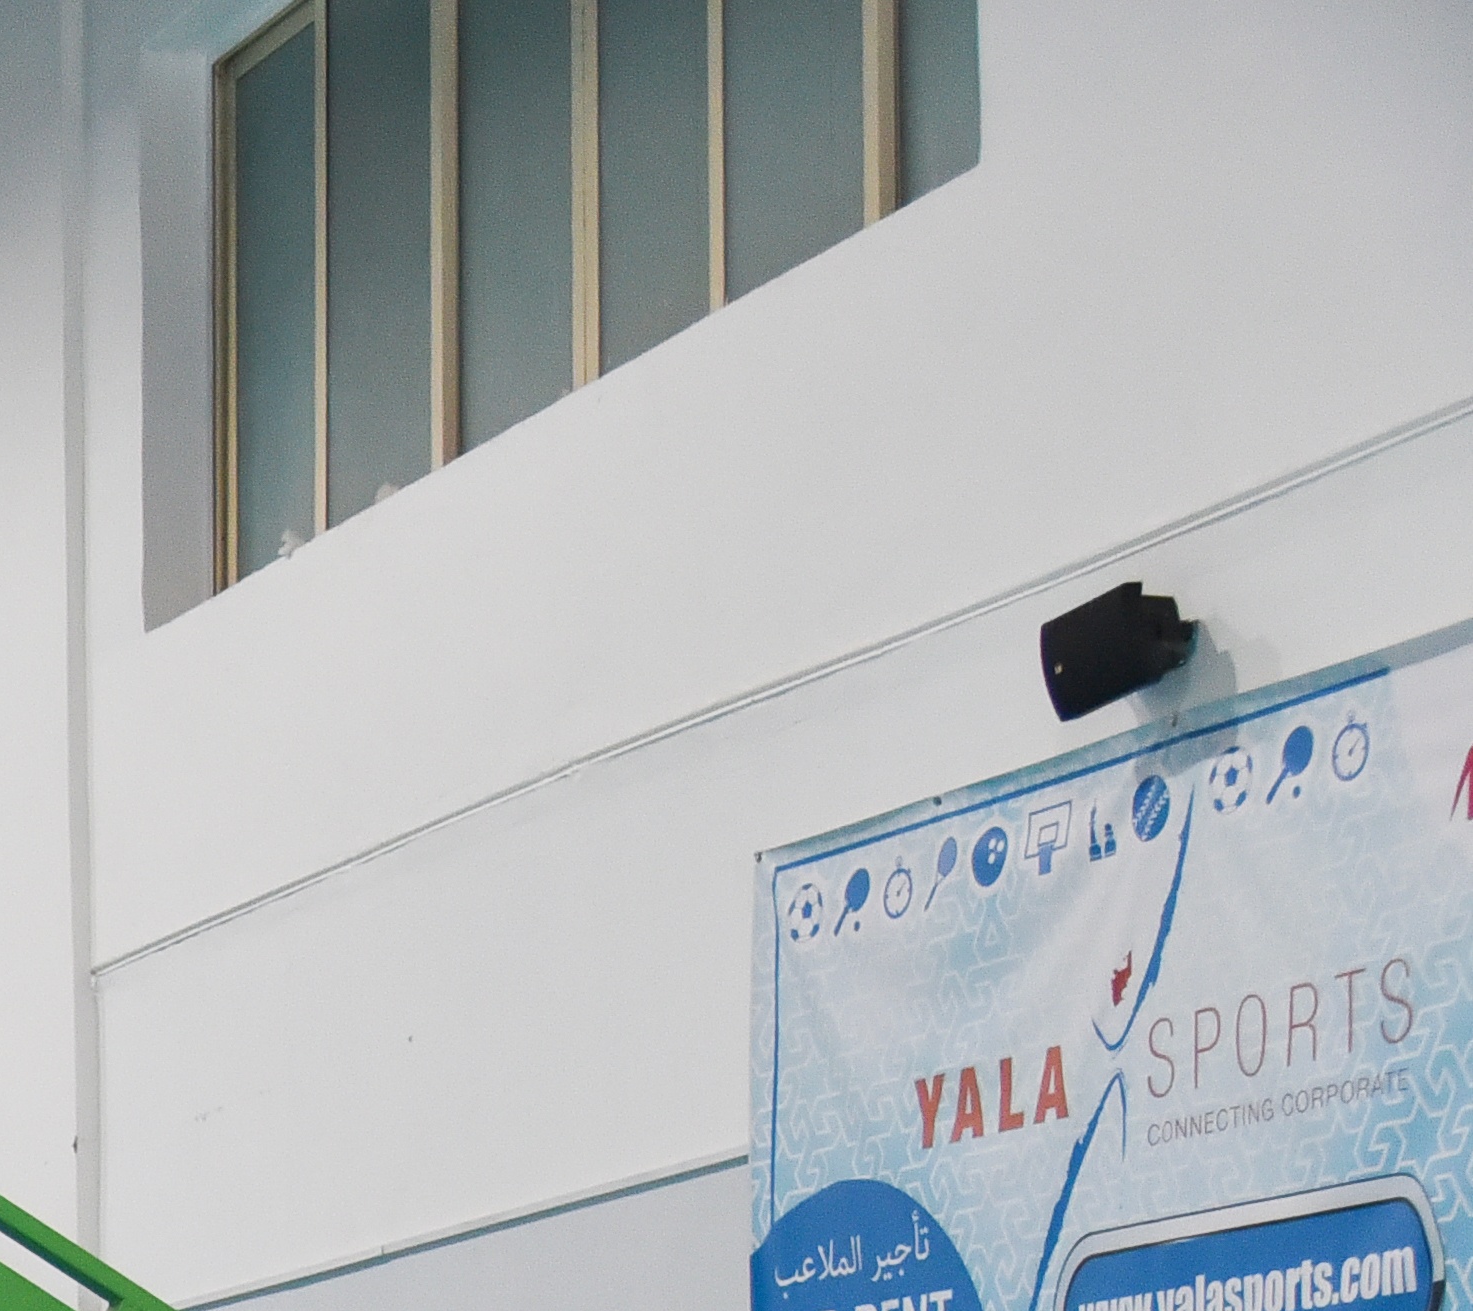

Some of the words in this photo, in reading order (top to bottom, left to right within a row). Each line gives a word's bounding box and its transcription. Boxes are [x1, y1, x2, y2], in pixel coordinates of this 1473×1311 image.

[915, 1045, 1069, 1149] YALA
[1148, 958, 1413, 1099] SPORTS
[1147, 1098, 1275, 1147] CONNECTING
[1281, 1068, 1410, 1117] CORPORATE
[774, 1234, 863, 1300] الملاعب
[871, 1210, 930, 1282] تأجير
